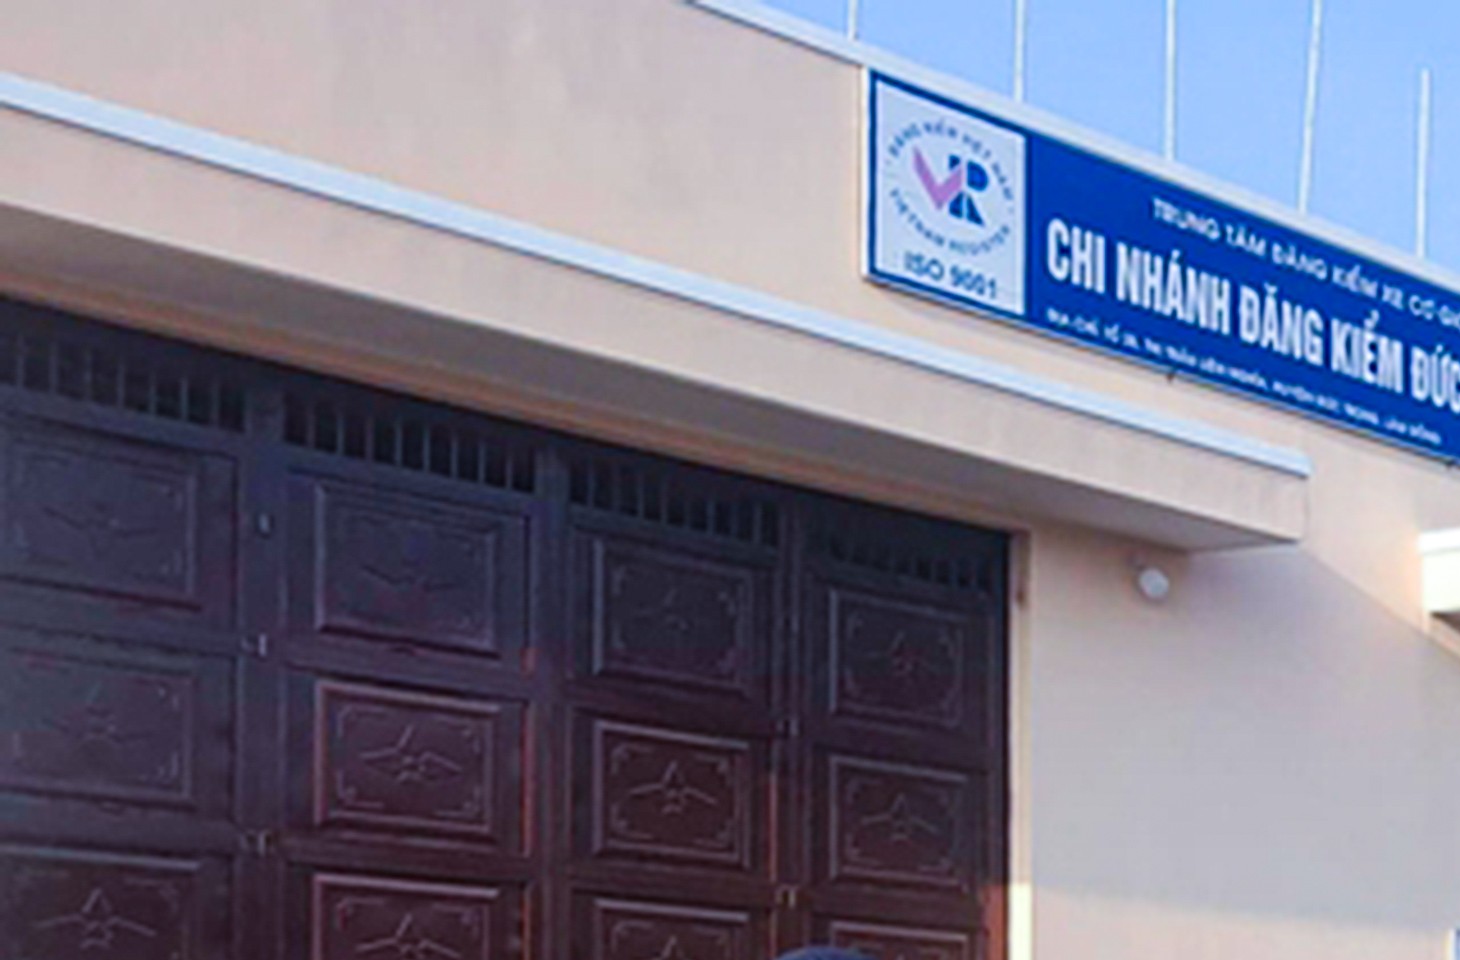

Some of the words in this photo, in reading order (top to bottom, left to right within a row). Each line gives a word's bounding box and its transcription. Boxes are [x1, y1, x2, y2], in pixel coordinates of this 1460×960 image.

[903, 250, 944, 282] ISO
[949, 263, 998, 300] 9001
[1047, 217, 1106, 294] CHI
[1116, 241, 1231, 336] NHÁNH
[1238, 282, 1325, 367] ĐĂNG
[1330, 309, 1404, 394] KIỂM
[1152, 196, 1220, 241] TRUNG
[1224, 222, 1267, 257] TÂM
[1271, 241, 1328, 281] ĐĂNG
[1332, 263, 1379, 299] KIỂM
[1382, 284, 1404, 311] XE
[1408, 294, 1435, 321] CƠ
